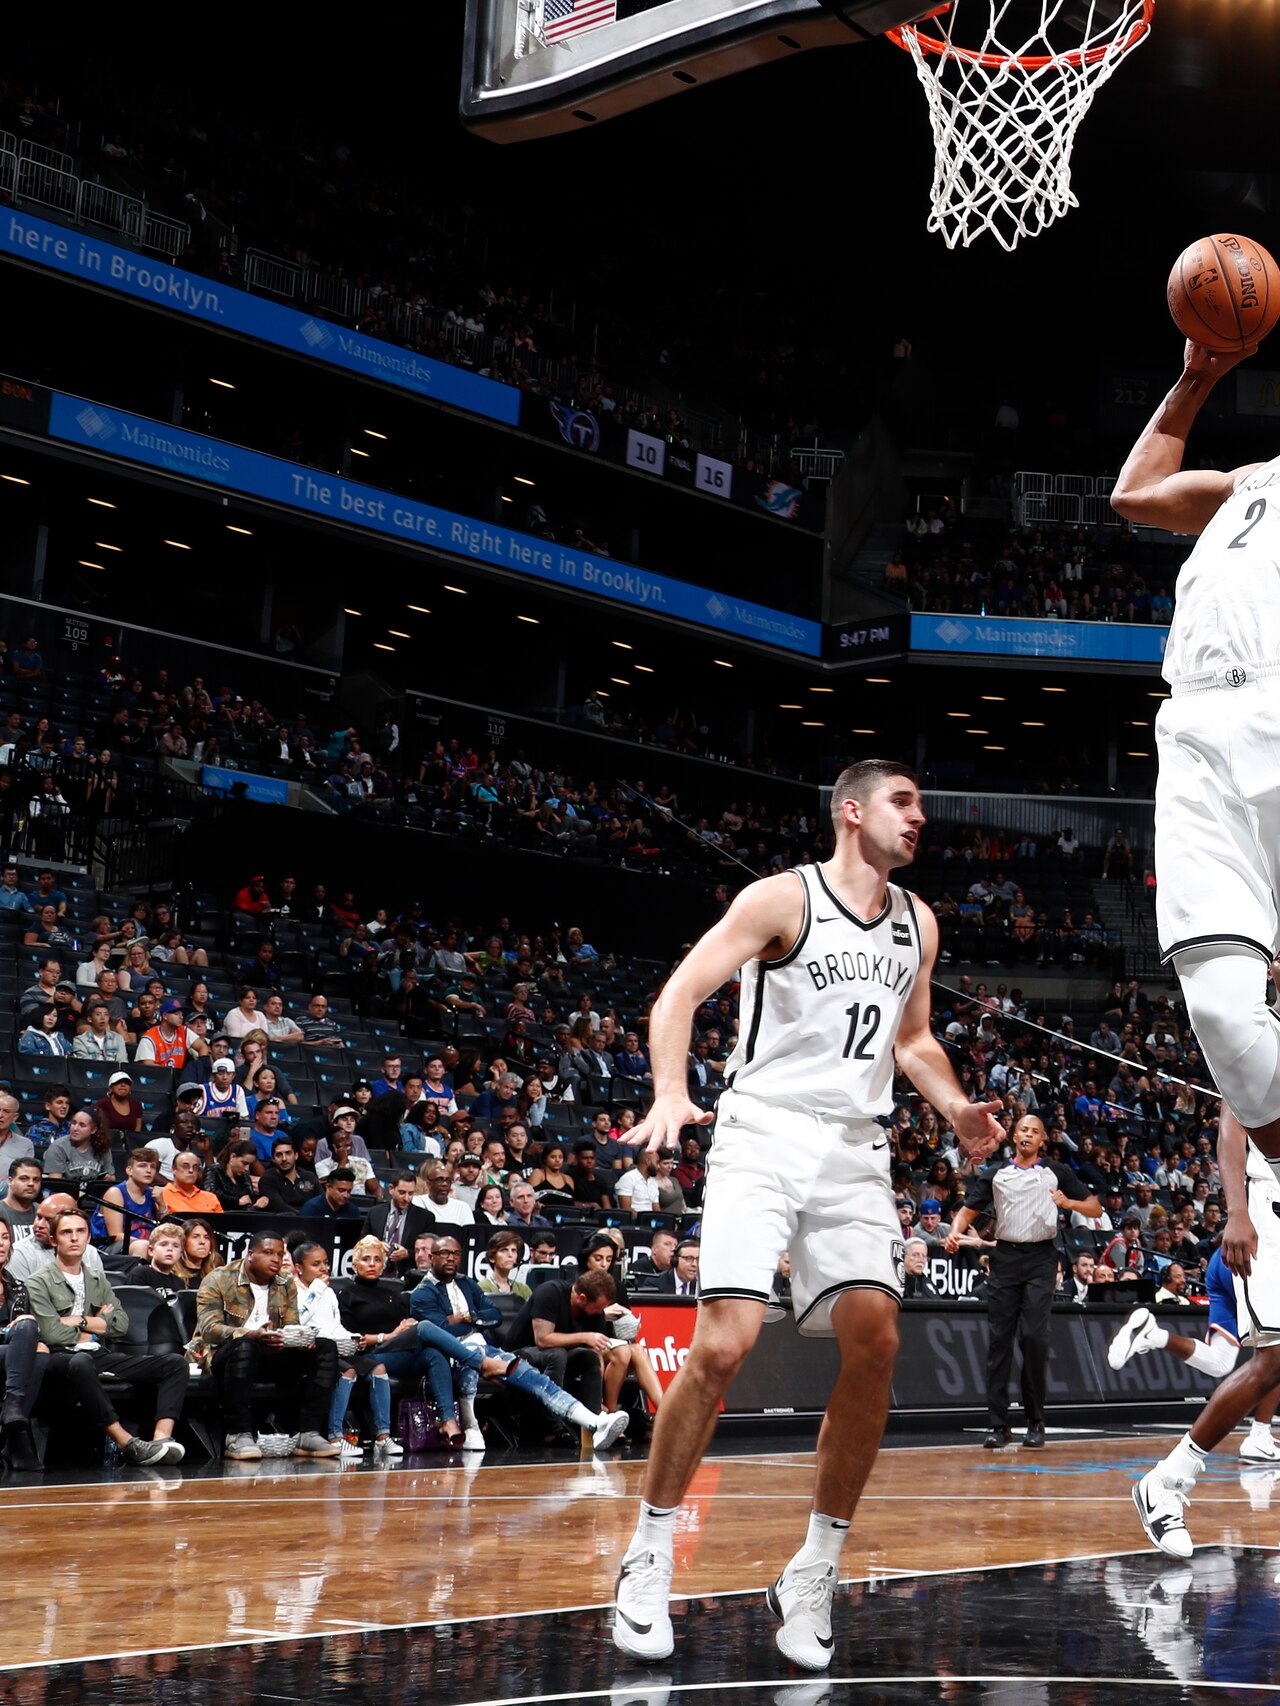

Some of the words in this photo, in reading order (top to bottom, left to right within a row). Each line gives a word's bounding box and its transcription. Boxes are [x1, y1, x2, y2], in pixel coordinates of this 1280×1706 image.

[8, 217, 69, 259] here
[78, 242, 100, 272] in
[110, 255, 225, 315] Brooklyn.
[338, 334, 432, 383] Maimonides
[121, 422, 232, 472] Maimonides
[636, 442, 657, 466] 10
[704, 466, 724, 489] 16
[291, 473, 333, 505] The
[340, 488, 387, 521] best
[392, 506, 443, 538] care.
[451, 521, 503, 555] Right
[508, 536, 553, 569] here
[559, 553, 577, 577] in
[582, 561, 667, 604] Brooklyn.
[1227, 498, 1267, 549] 2
[64, 625, 88, 641] 109
[734, 606, 807, 642] Maimonides
[868, 626, 890, 643] PM
[974, 625, 1077, 647] Maimonides
[488, 723, 505, 736] 110
[806, 951, 914, 998] BROOKLYN
[842, 1001, 881, 1061] 12
